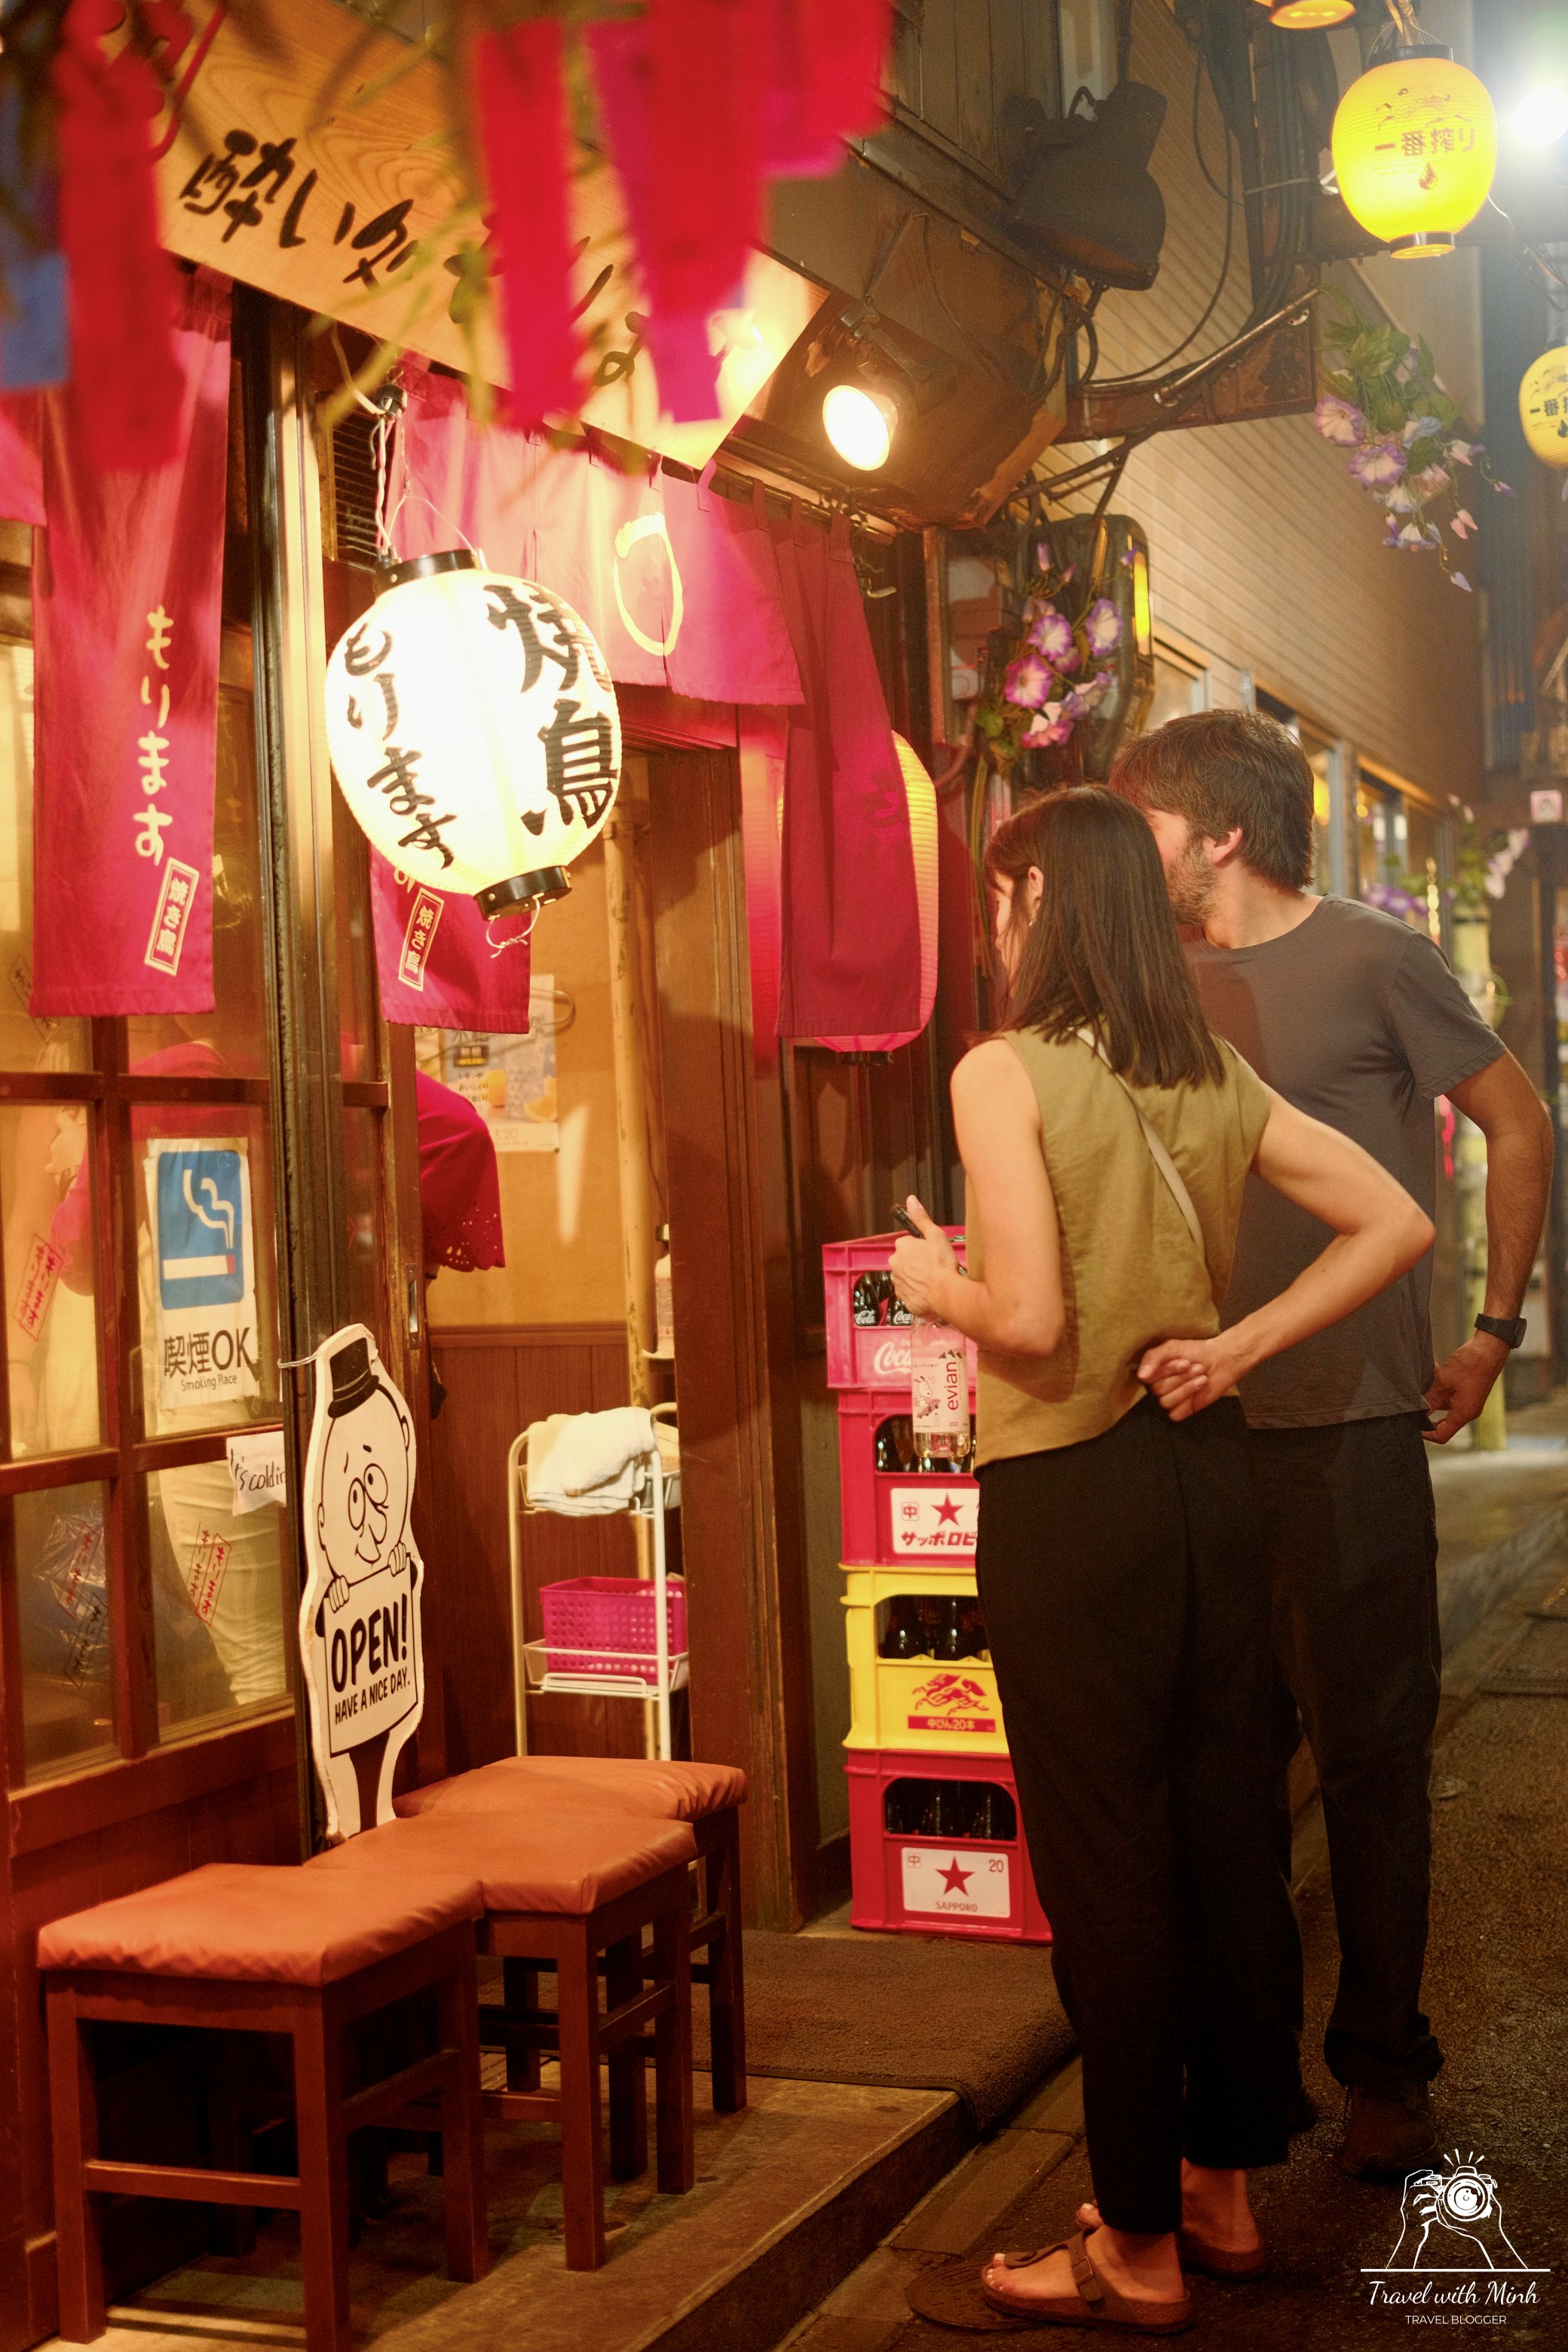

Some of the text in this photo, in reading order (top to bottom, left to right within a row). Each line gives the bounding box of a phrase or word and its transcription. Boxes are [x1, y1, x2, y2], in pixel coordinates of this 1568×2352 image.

[1374, 127, 1475, 157] 一番搾り
[1530, 396, 1568, 417] 一番
[482, 581, 620, 835] 焼鳥
[134, 605, 173, 865] もります
[345, 623, 457, 869] もります
[156, 877, 189, 957] 焼き鳥
[405, 905, 435, 974] 焼き鳥
[181, 1374, 237, 1392] Smoking Place
[945, 1361, 959, 1410] evian
[249, 1461, 274, 1490] cold
[903, 1504, 917, 1519] 中
[331, 1593, 408, 1693] OPEN!
[335, 1667, 410, 1725] HAVE A NICE DAY.
[927, 1718, 975, 1730] 中びん20本
[909, 1854, 920, 1867] 中
[989, 1859, 1004, 1873] 20
[936, 1900, 978, 1913] SAPPORO
